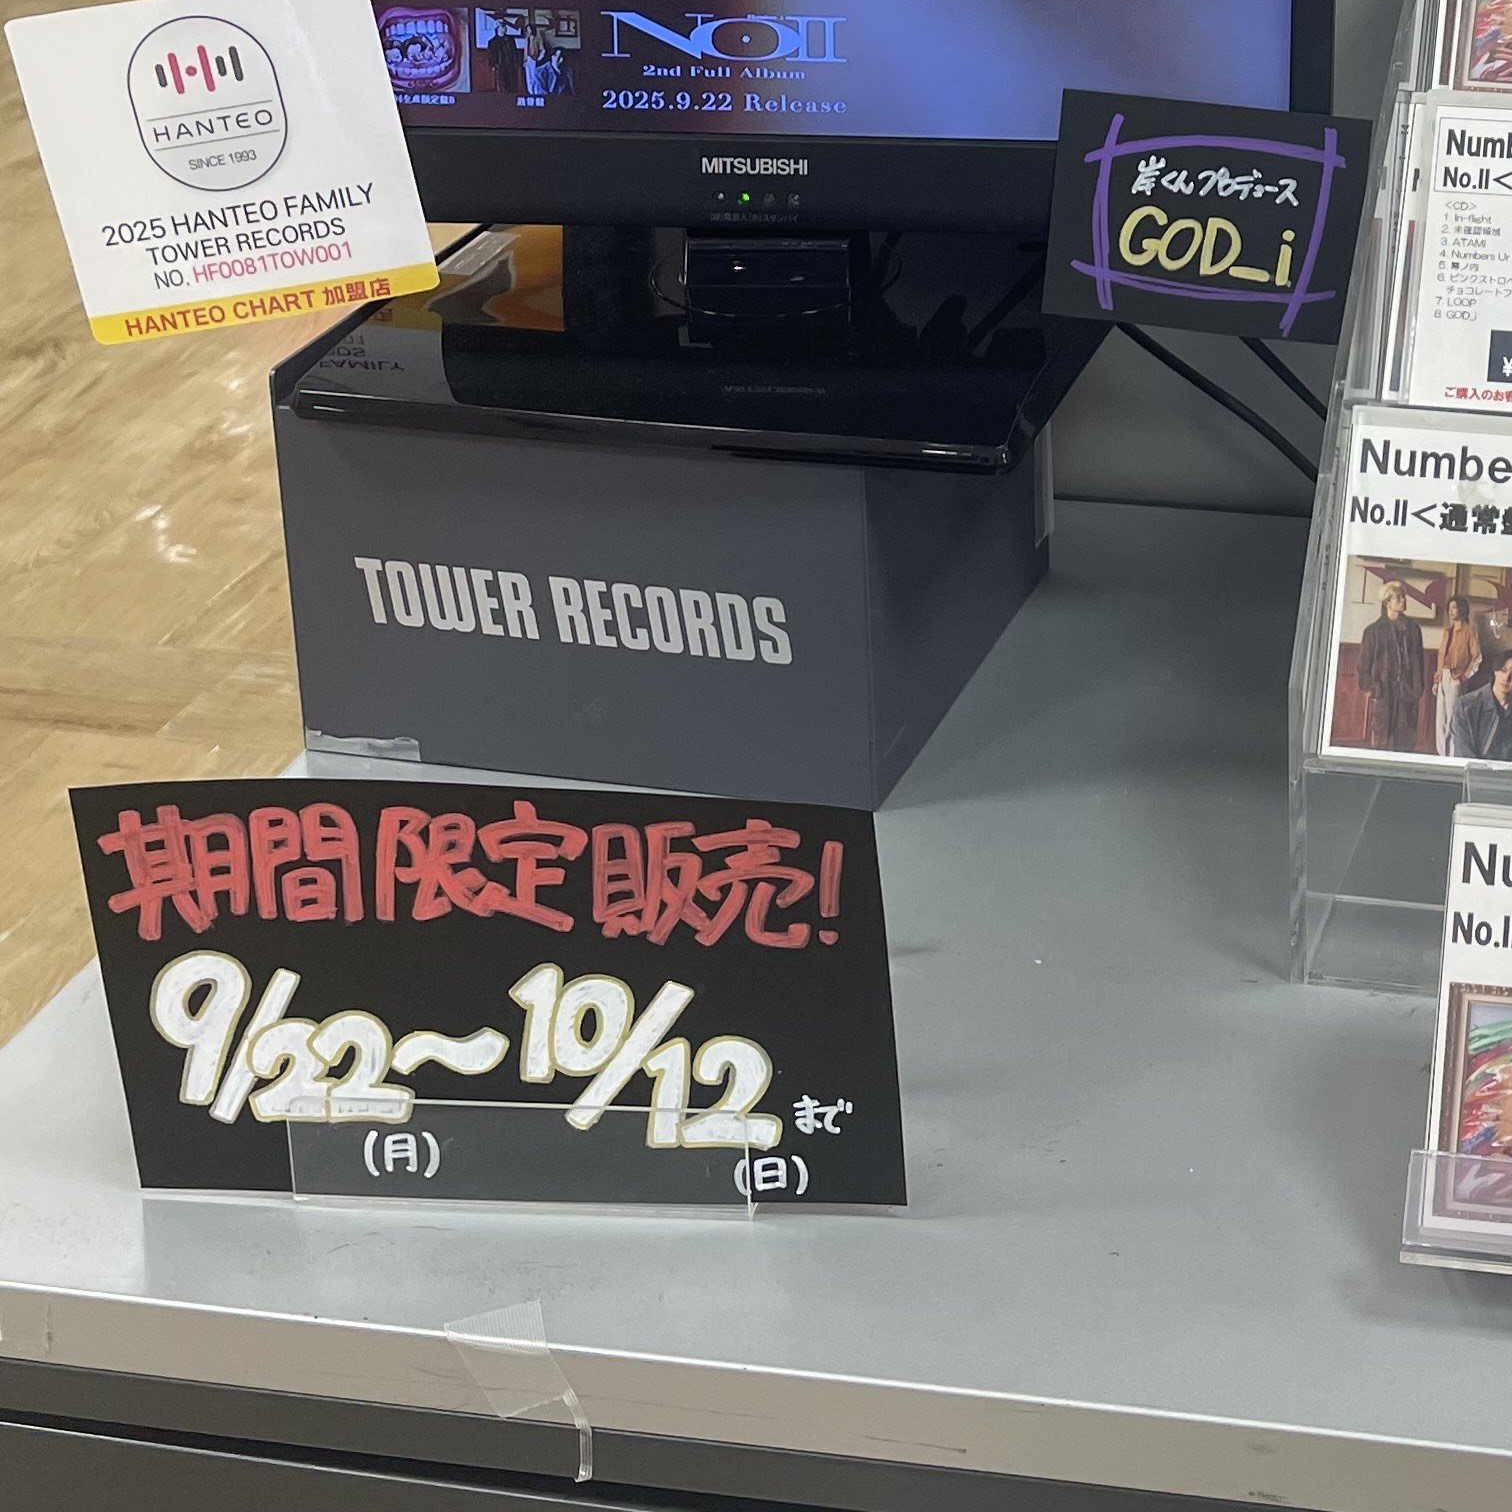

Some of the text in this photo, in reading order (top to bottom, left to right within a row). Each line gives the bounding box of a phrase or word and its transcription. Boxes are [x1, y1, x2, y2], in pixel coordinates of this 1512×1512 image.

[642, 65, 806, 80] 2nd Full Album
[152, 108, 273, 142] HANTEO
[601, 90, 847, 114] 2025.9.22 Release
[188, 149, 257, 170] SINCE 1993
[701, 157, 808, 176] MITSUBISHI
[1131, 155, 1299, 207] 岸くんプロデュース
[102, 183, 374, 247] 2025 HANTEO FAMILY
[146, 217, 345, 266] TOWER RECORDS
[155, 241, 353, 290] NO. HF0081TOW001
[1118, 205, 1296, 287] GOD_i
[125, 277, 392, 338] HANTEO CHART 加盟店
[354, 556, 793, 665] TOWER RECORDS
[97, 799, 844, 948] 期間限定販売!
[792, 1094, 855, 1134] まで
[362, 1129, 809, 1195] (月) (日)
